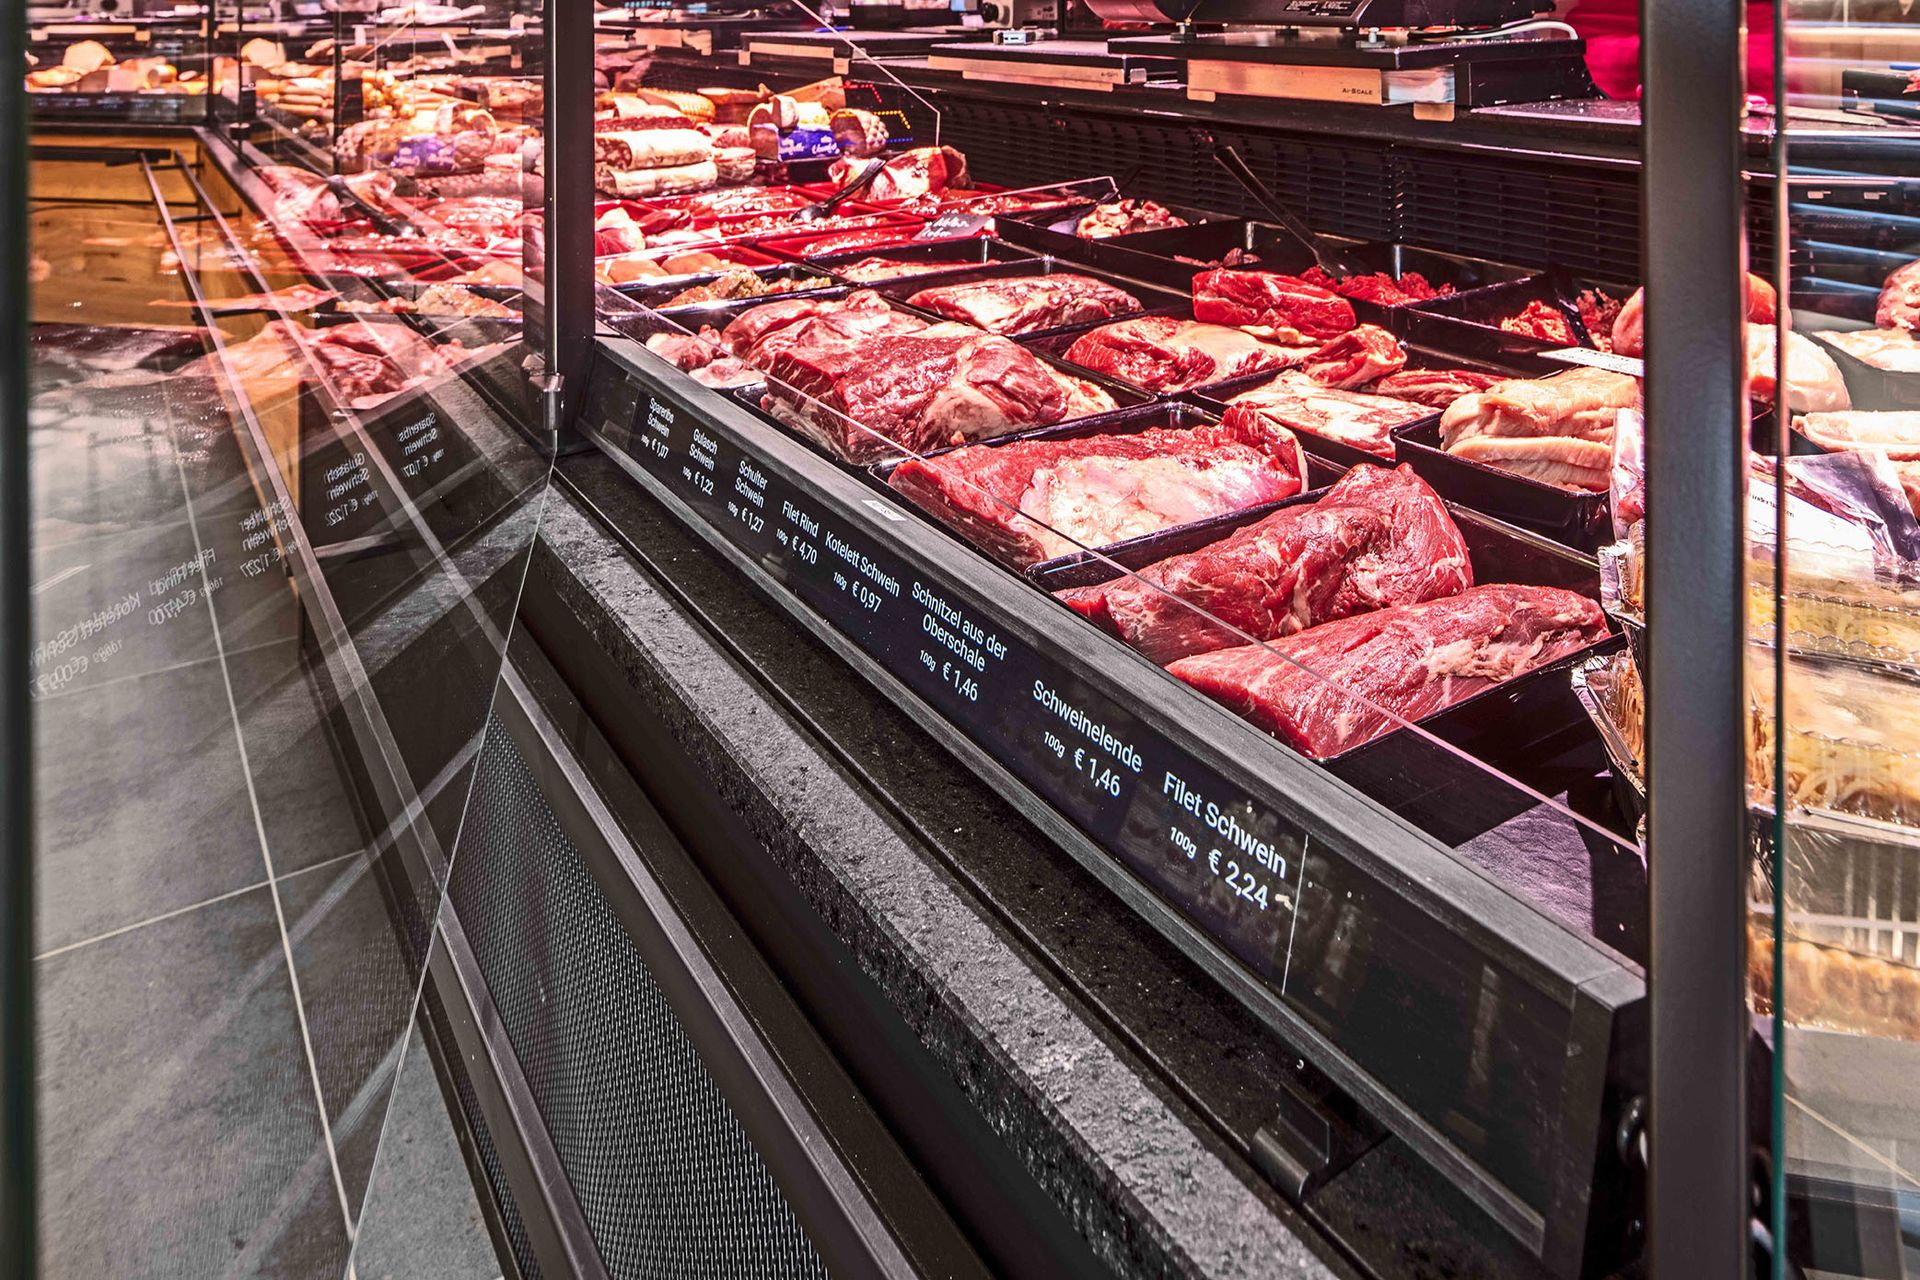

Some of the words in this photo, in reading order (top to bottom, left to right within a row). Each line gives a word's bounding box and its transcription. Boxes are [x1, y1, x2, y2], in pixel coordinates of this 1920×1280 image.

[647, 413, 670, 438] Schwein
[649, 397, 674, 424] Spareribs
[651, 438, 657, 450] €
[657, 441, 669, 459] 1,07
[689, 443, 715, 471] Schwein
[693, 428, 718, 455] Gulasch
[694, 471, 700, 485] €
[700, 475, 714, 495] 1,22
[735, 477, 764, 508] Schwein
[738, 460, 768, 490] Schulter
[727, 501, 738, 517] 100g
[741, 507, 748, 522] €
[748, 512, 764, 533] 1,27
[782, 500, 800, 524] Filet
[799, 512, 819, 538] Rind
[776, 528, 788, 545] 100g
[792, 535, 799, 551] €
[799, 541, 817, 565] 4,70
[825, 531, 860, 568] Kotelett
[860, 556, 900, 597] Schwein
[833, 571, 848, 591] 100g
[852, 580, 860, 597] €
[860, 586, 882, 613] 0,97
[911, 581, 962, 629] Schnitzel
[962, 619, 985, 645] aus
[986, 634, 1008, 661] der
[922, 613, 985, 672] Oberschale
[919, 650, 936, 672] 100g
[942, 661, 951, 681] €
[954, 670, 978, 701] 1,46
[1032, 679, 1142, 773] Schweinelende
[1043, 731, 1066, 759] 100g
[1074, 747, 1085, 771] €
[1089, 758, 1121, 797] 1,46
[1163, 771, 1203, 818] Filet
[1205, 802, 1287, 879] Schwein
[1170, 826, 1197, 860] 100g
[1208, 848, 1222, 876] €
[1225, 860, 1268, 911] 2,24
